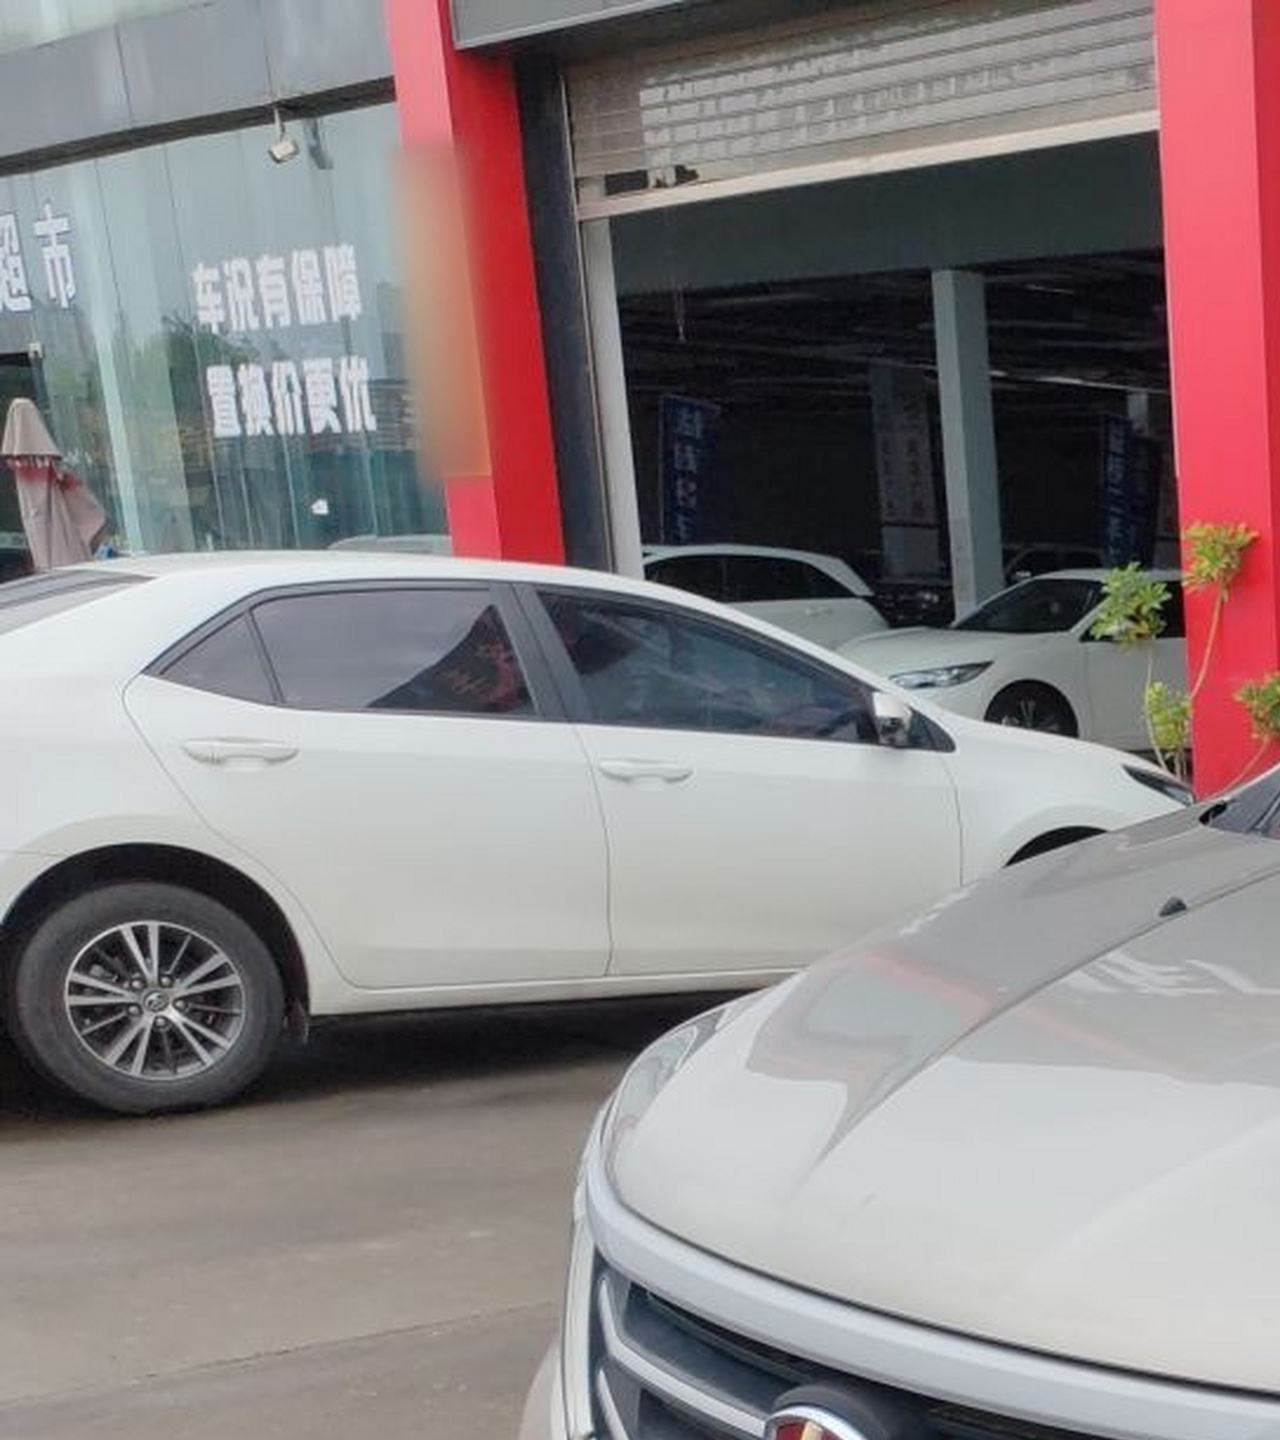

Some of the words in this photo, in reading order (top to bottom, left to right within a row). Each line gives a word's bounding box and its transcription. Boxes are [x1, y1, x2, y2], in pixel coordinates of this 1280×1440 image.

[193, 244, 362, 334] 车况有保障
[206, 355, 378, 438] 置换价更优
